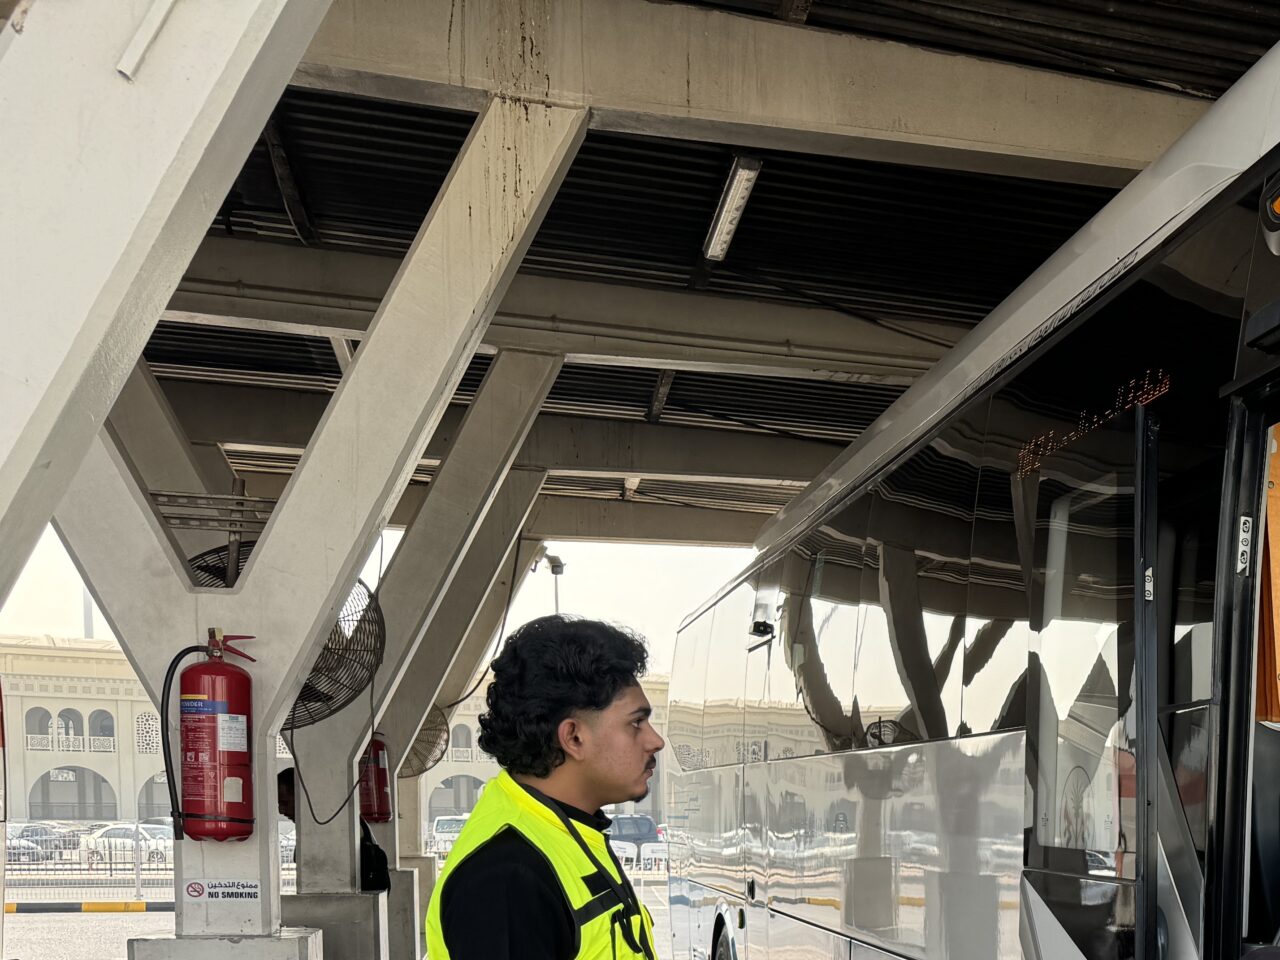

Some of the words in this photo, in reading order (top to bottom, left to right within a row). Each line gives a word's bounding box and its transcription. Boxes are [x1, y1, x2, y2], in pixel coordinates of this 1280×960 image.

[207, 881, 235, 890] التدخين
[236, 881, 259, 890] ممنوع
[208, 891, 220, 899] NO
[221, 891, 258, 899] SMOKING
